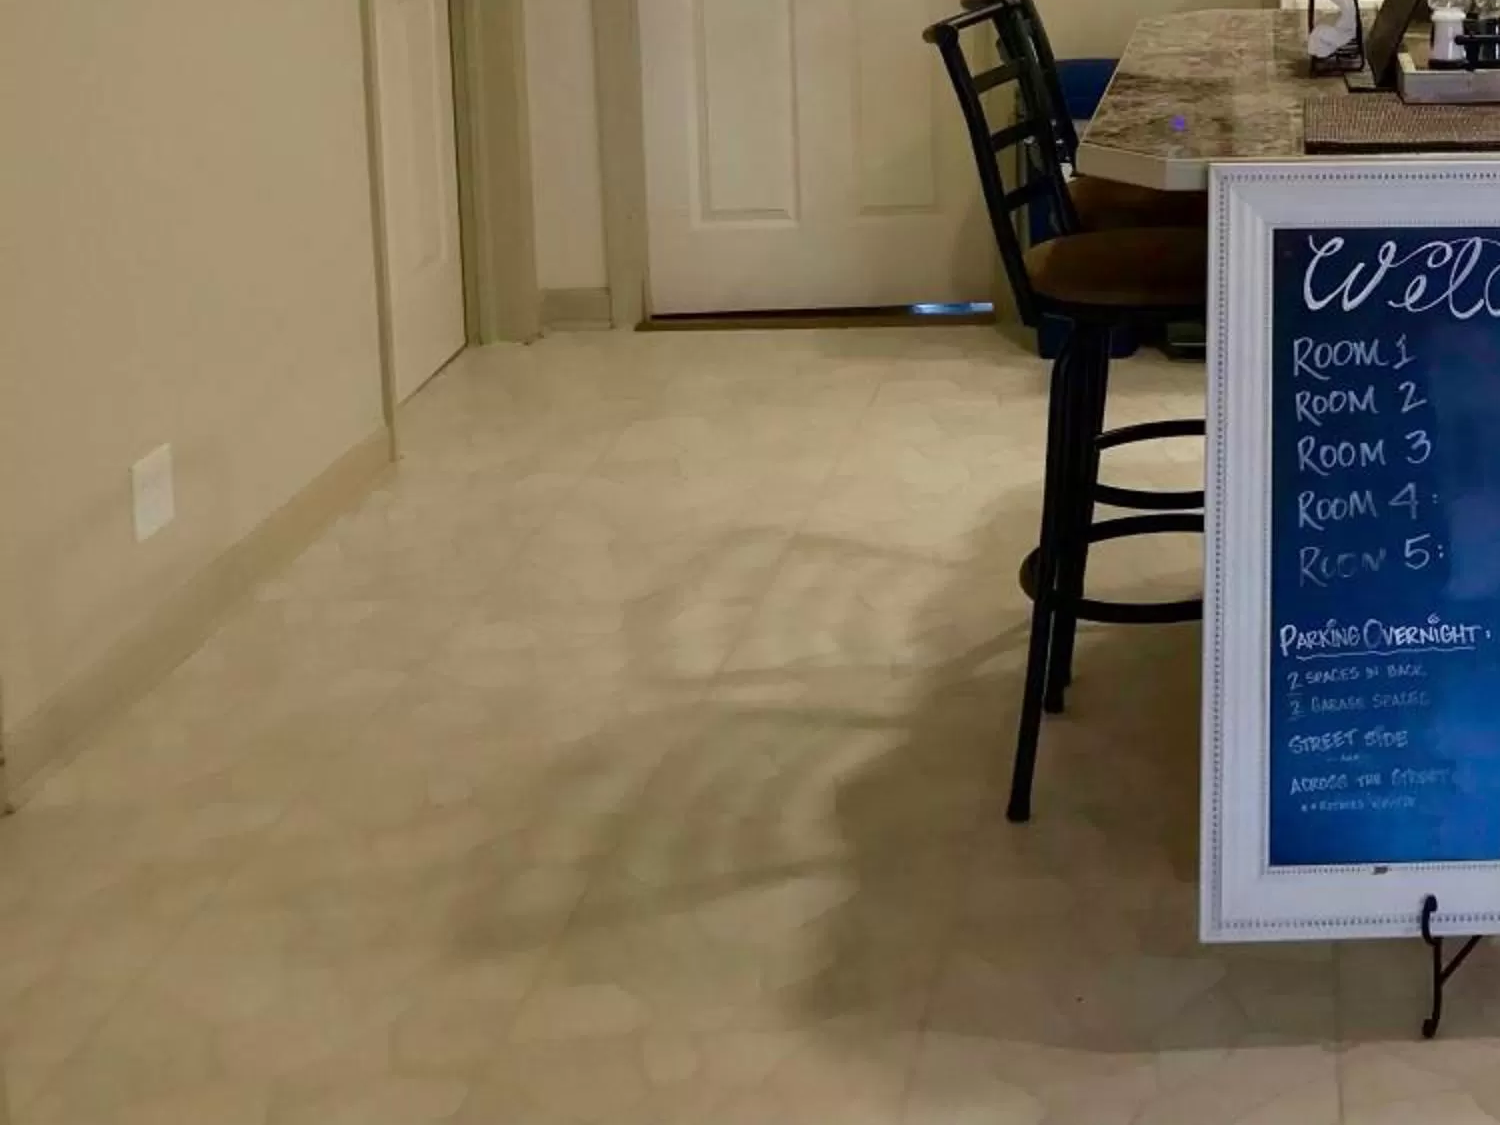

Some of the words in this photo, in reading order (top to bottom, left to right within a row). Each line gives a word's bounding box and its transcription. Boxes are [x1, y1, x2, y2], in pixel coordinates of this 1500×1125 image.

[1293, 336, 1390, 380] ROOM
[1392, 333, 1416, 369] 1
[1295, 385, 1379, 426] ROOM
[1399, 381, 1427, 413] 2
[1297, 435, 1387, 476] ROOM
[1405, 430, 1431, 464] 3
[1297, 490, 1379, 531] ROOM
[1280, 618, 1361, 657] PARKING
[1288, 728, 1359, 754] STREET
